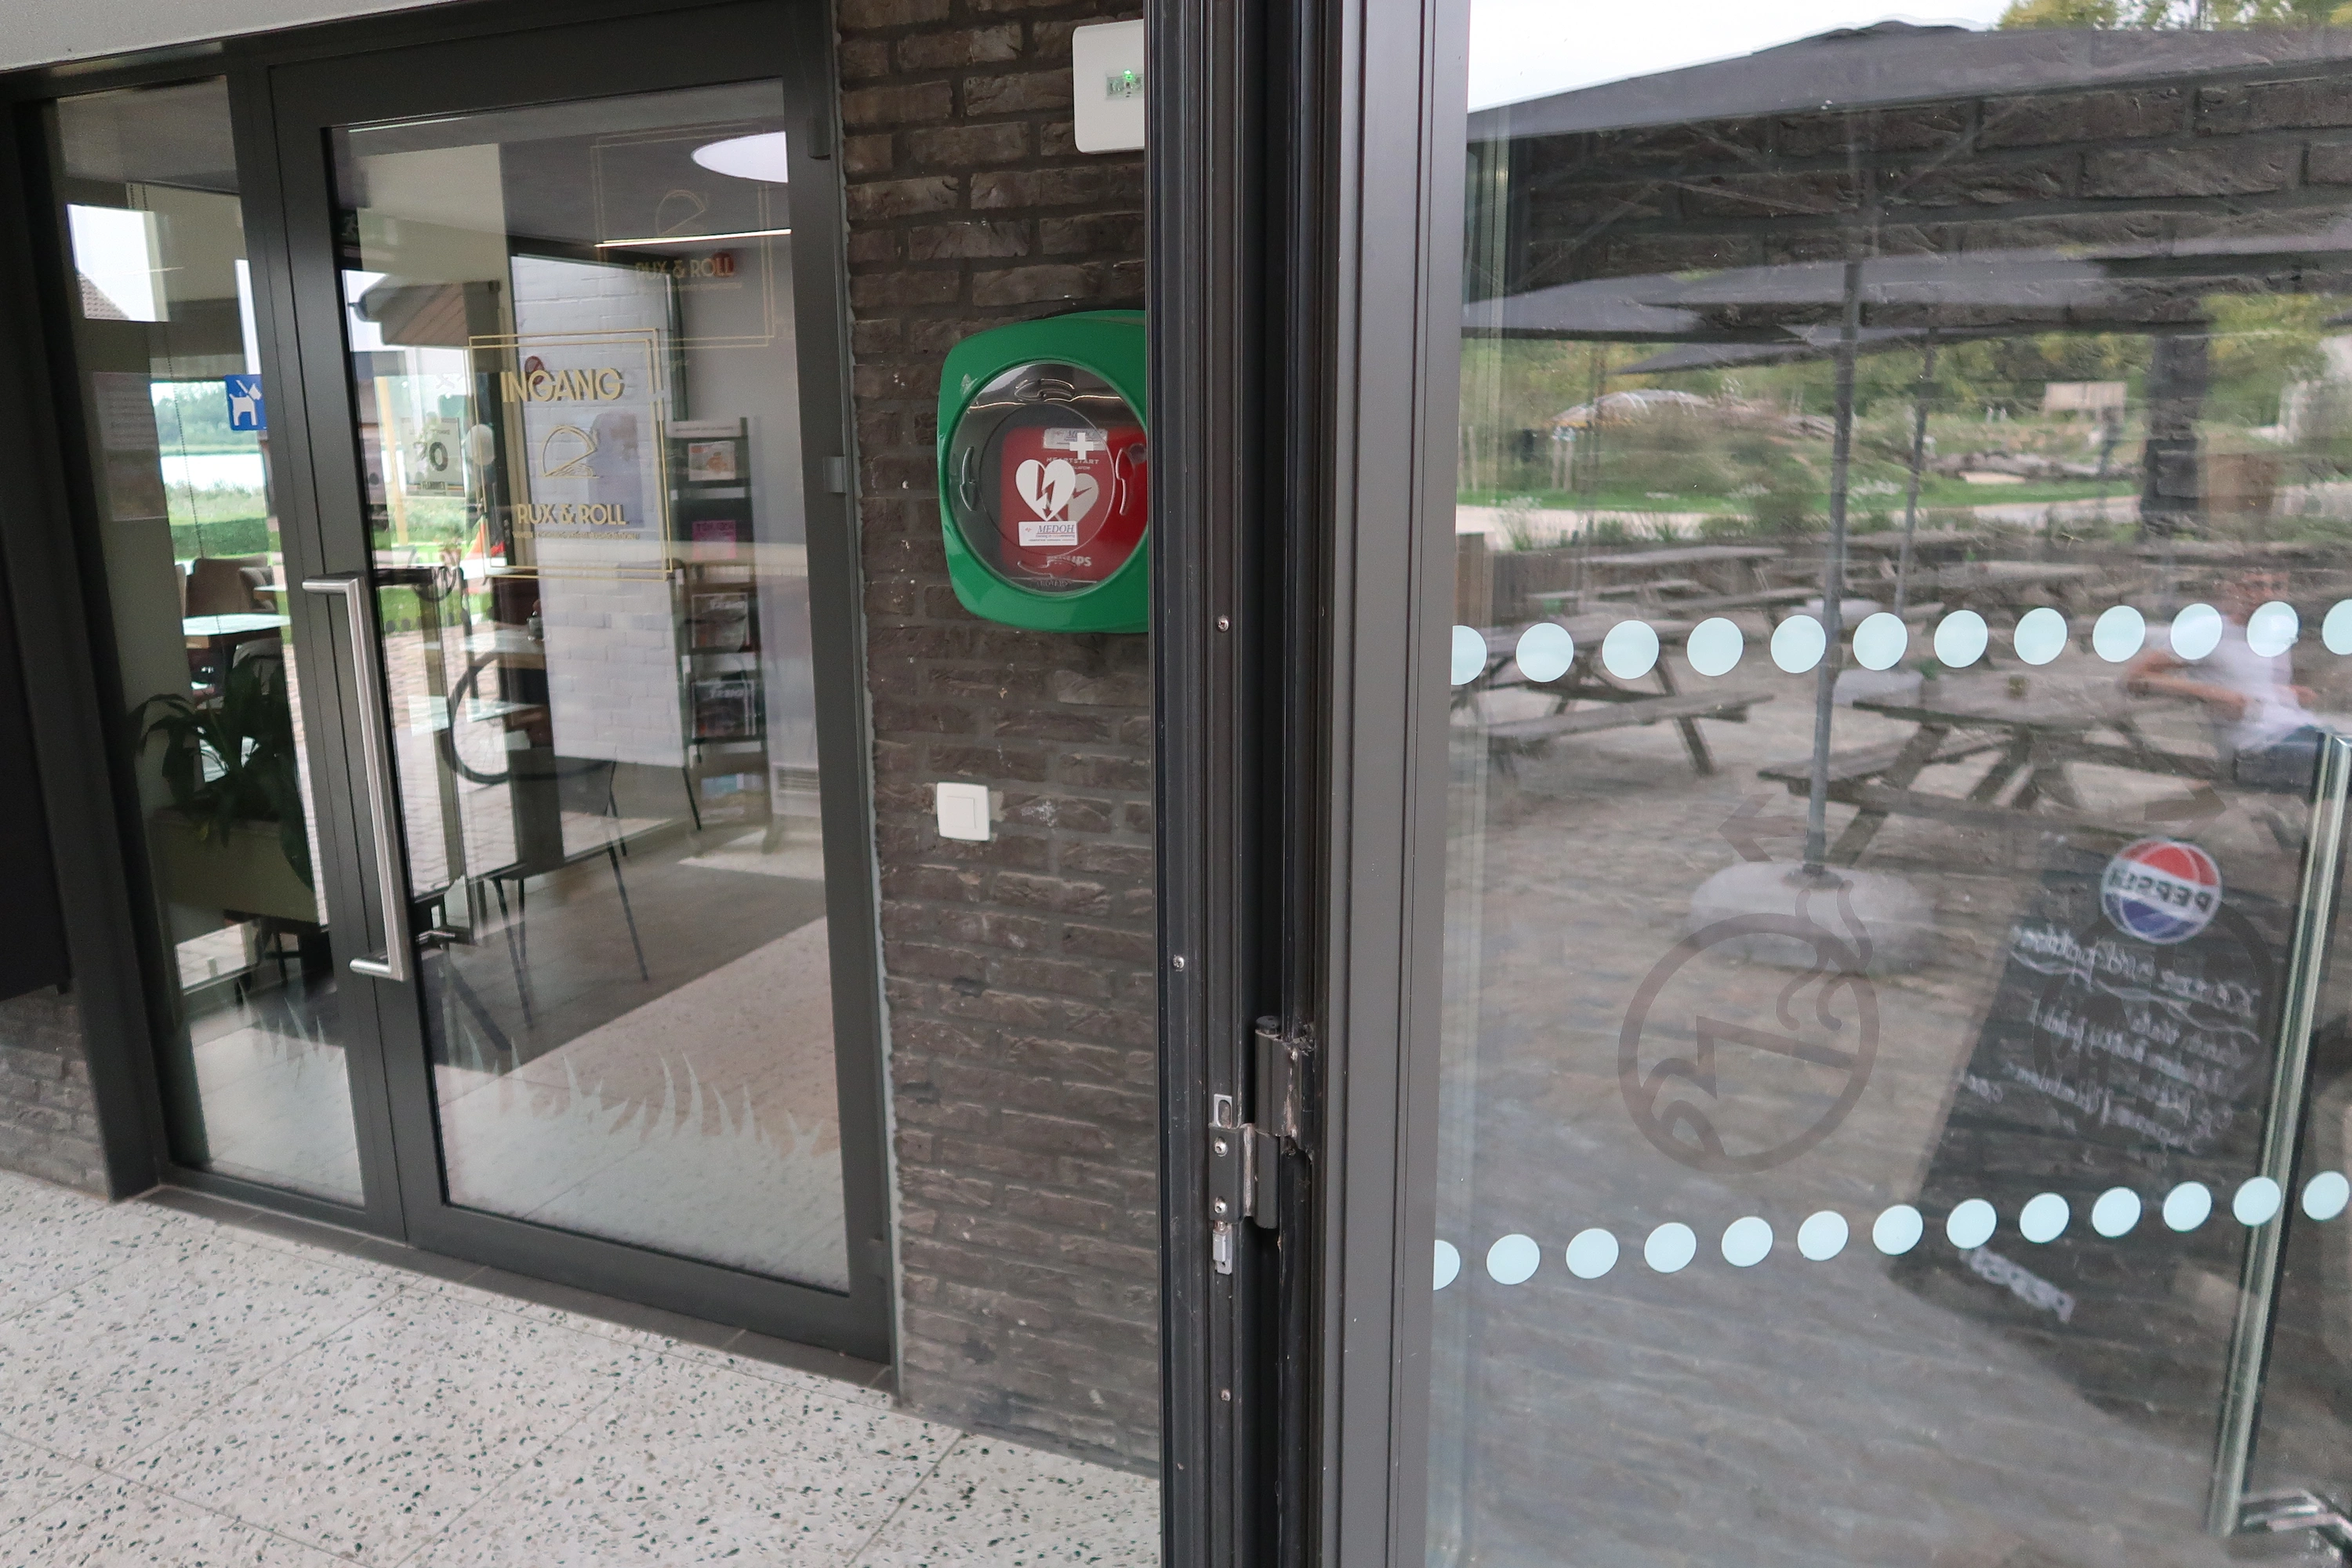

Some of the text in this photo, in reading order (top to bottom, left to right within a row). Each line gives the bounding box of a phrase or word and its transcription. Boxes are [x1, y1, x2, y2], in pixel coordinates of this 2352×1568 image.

[690, 257, 735, 278] ROLL
[500, 368, 624, 402] INGANG
[517, 503, 628, 525] RUX & ROLL
[1037, 524, 1075, 533] MEDOH
